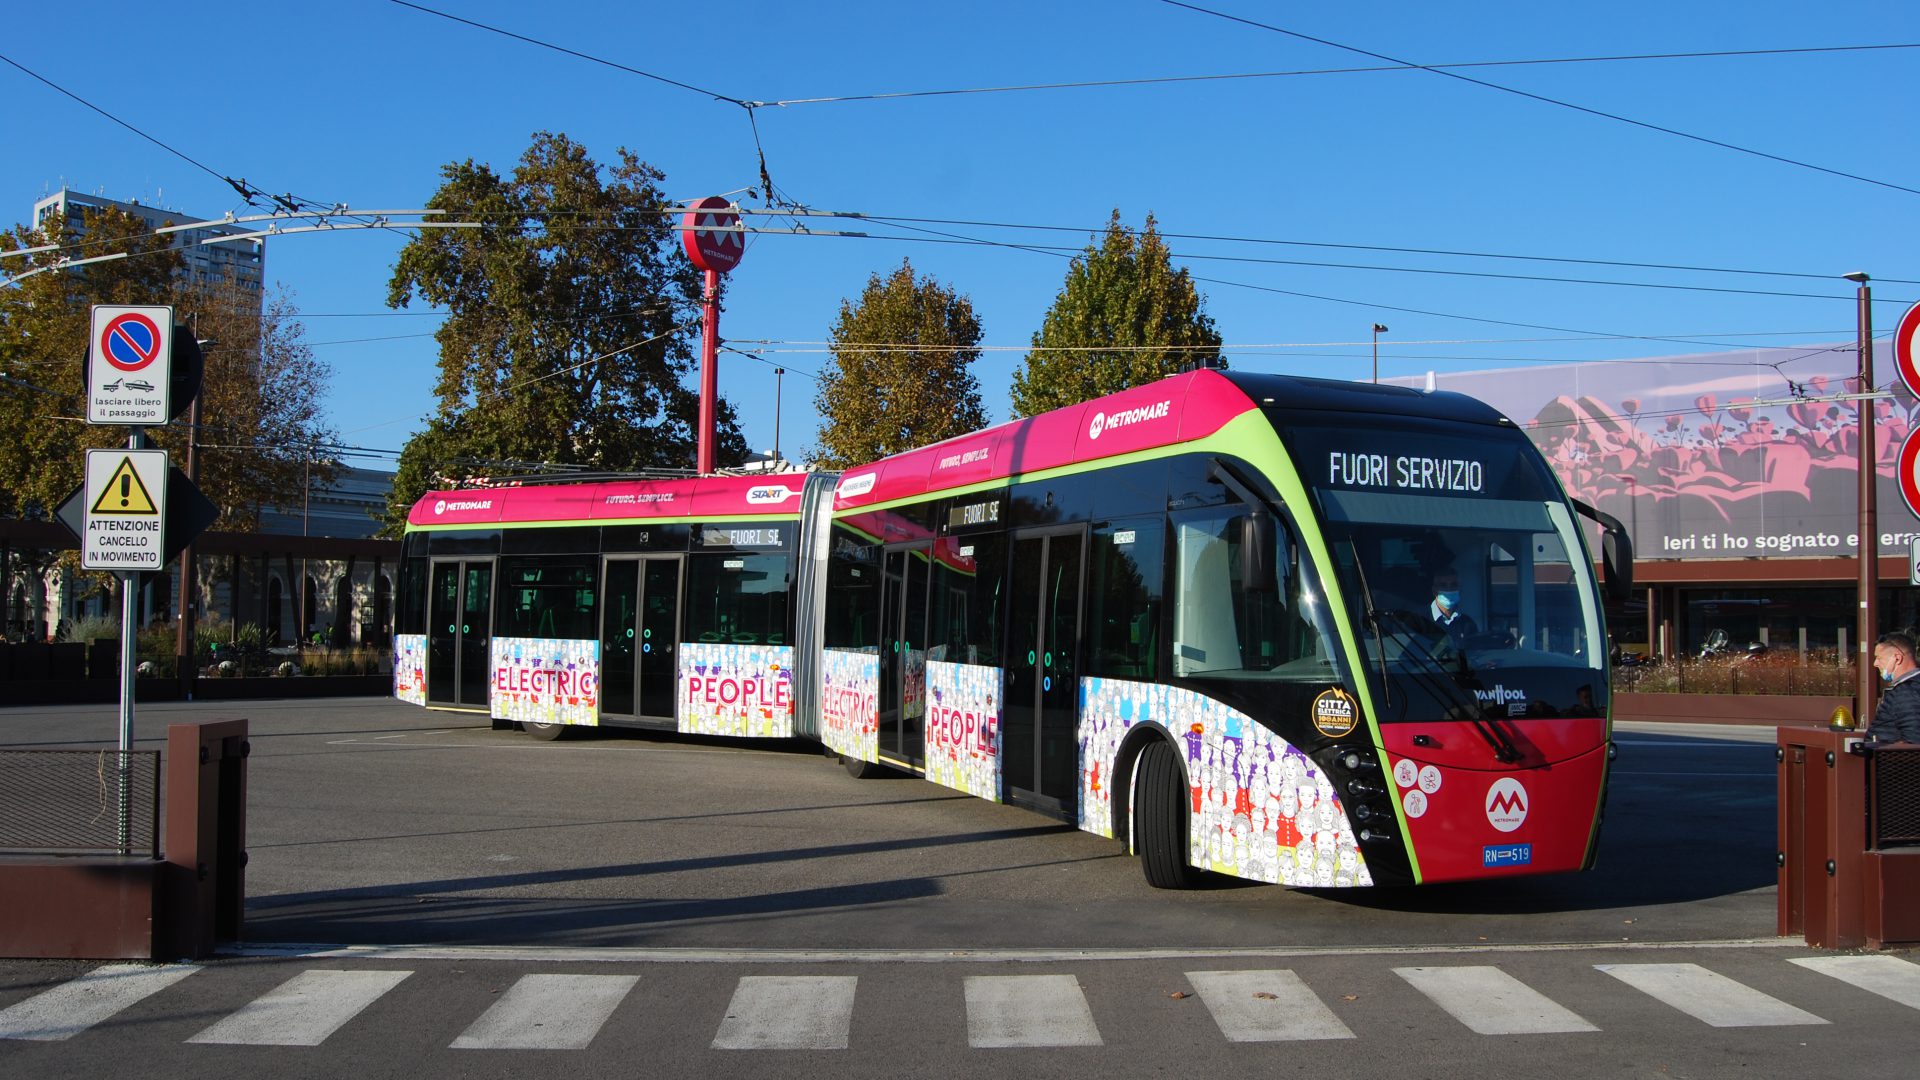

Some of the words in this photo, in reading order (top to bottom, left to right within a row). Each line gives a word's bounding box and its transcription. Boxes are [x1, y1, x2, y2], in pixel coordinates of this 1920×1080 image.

[703, 248, 735, 263] METROMARE
[95, 398, 132, 406] lasciare
[134, 398, 162, 406] libero
[100, 408, 106, 416] il
[109, 409, 156, 418] passaggio
[1105, 400, 1171, 430] METROMARE
[1330, 452, 1388, 487] FUORI
[1396, 456, 1482, 492] SERVIZIO
[751, 488, 784, 499] START
[446, 500, 492, 511] METROMARE
[964, 502, 986, 525] FUORI
[89, 520, 160, 532] ATTENZIONE
[99, 536, 148, 547] CANCELLO
[730, 529, 761, 545] FUORI
[1663, 535, 1696, 550] Ieri
[1702, 534, 1717, 549] ti
[1723, 533, 1749, 549] ho
[1755, 532, 1840, 551] sognato
[89, 551, 99, 562] IN
[101, 551, 157, 563] MOVIMENTO
[497, 667, 593, 696] ELECTRIC
[688, 676, 790, 708] PEOPLE
[823, 686, 875, 726] ELECTRIC
[931, 706, 998, 755] PEOPLE
[1485, 849, 1498, 863] RN
[1511, 847, 1529, 861] 519
